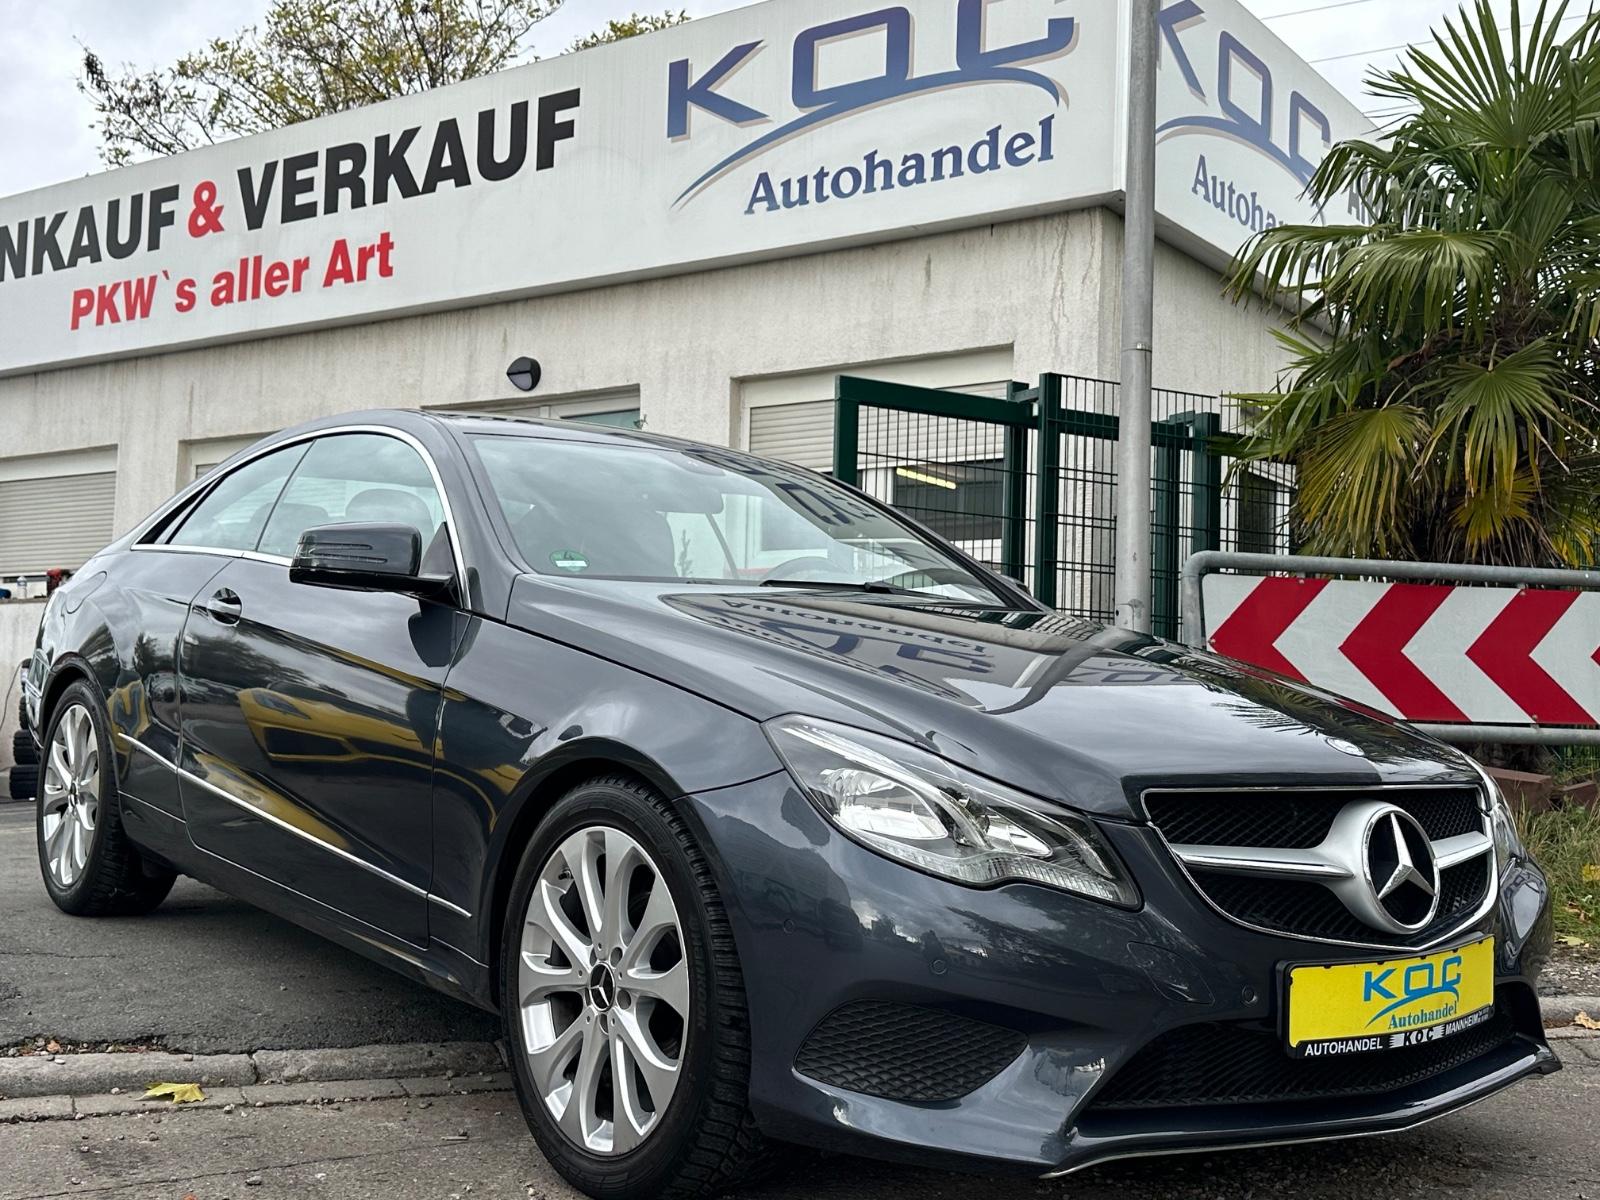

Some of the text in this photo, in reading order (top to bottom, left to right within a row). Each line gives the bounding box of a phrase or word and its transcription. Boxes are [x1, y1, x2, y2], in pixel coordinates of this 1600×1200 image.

[0, 88, 580, 282] NKAUF & VERKAUF
[745, 115, 1053, 214] Autohandel
[211, 256, 309, 306] aller
[324, 232, 393, 287] Art
[1363, 956, 1461, 1001] KOC
[1305, 1037, 1383, 1056] AUTOHANDEL
[1404, 1028, 1434, 1045] KOC
[1445, 1012, 1479, 1035] MANNHEIM
[1388, 1001, 1457, 1029] Autohandel
